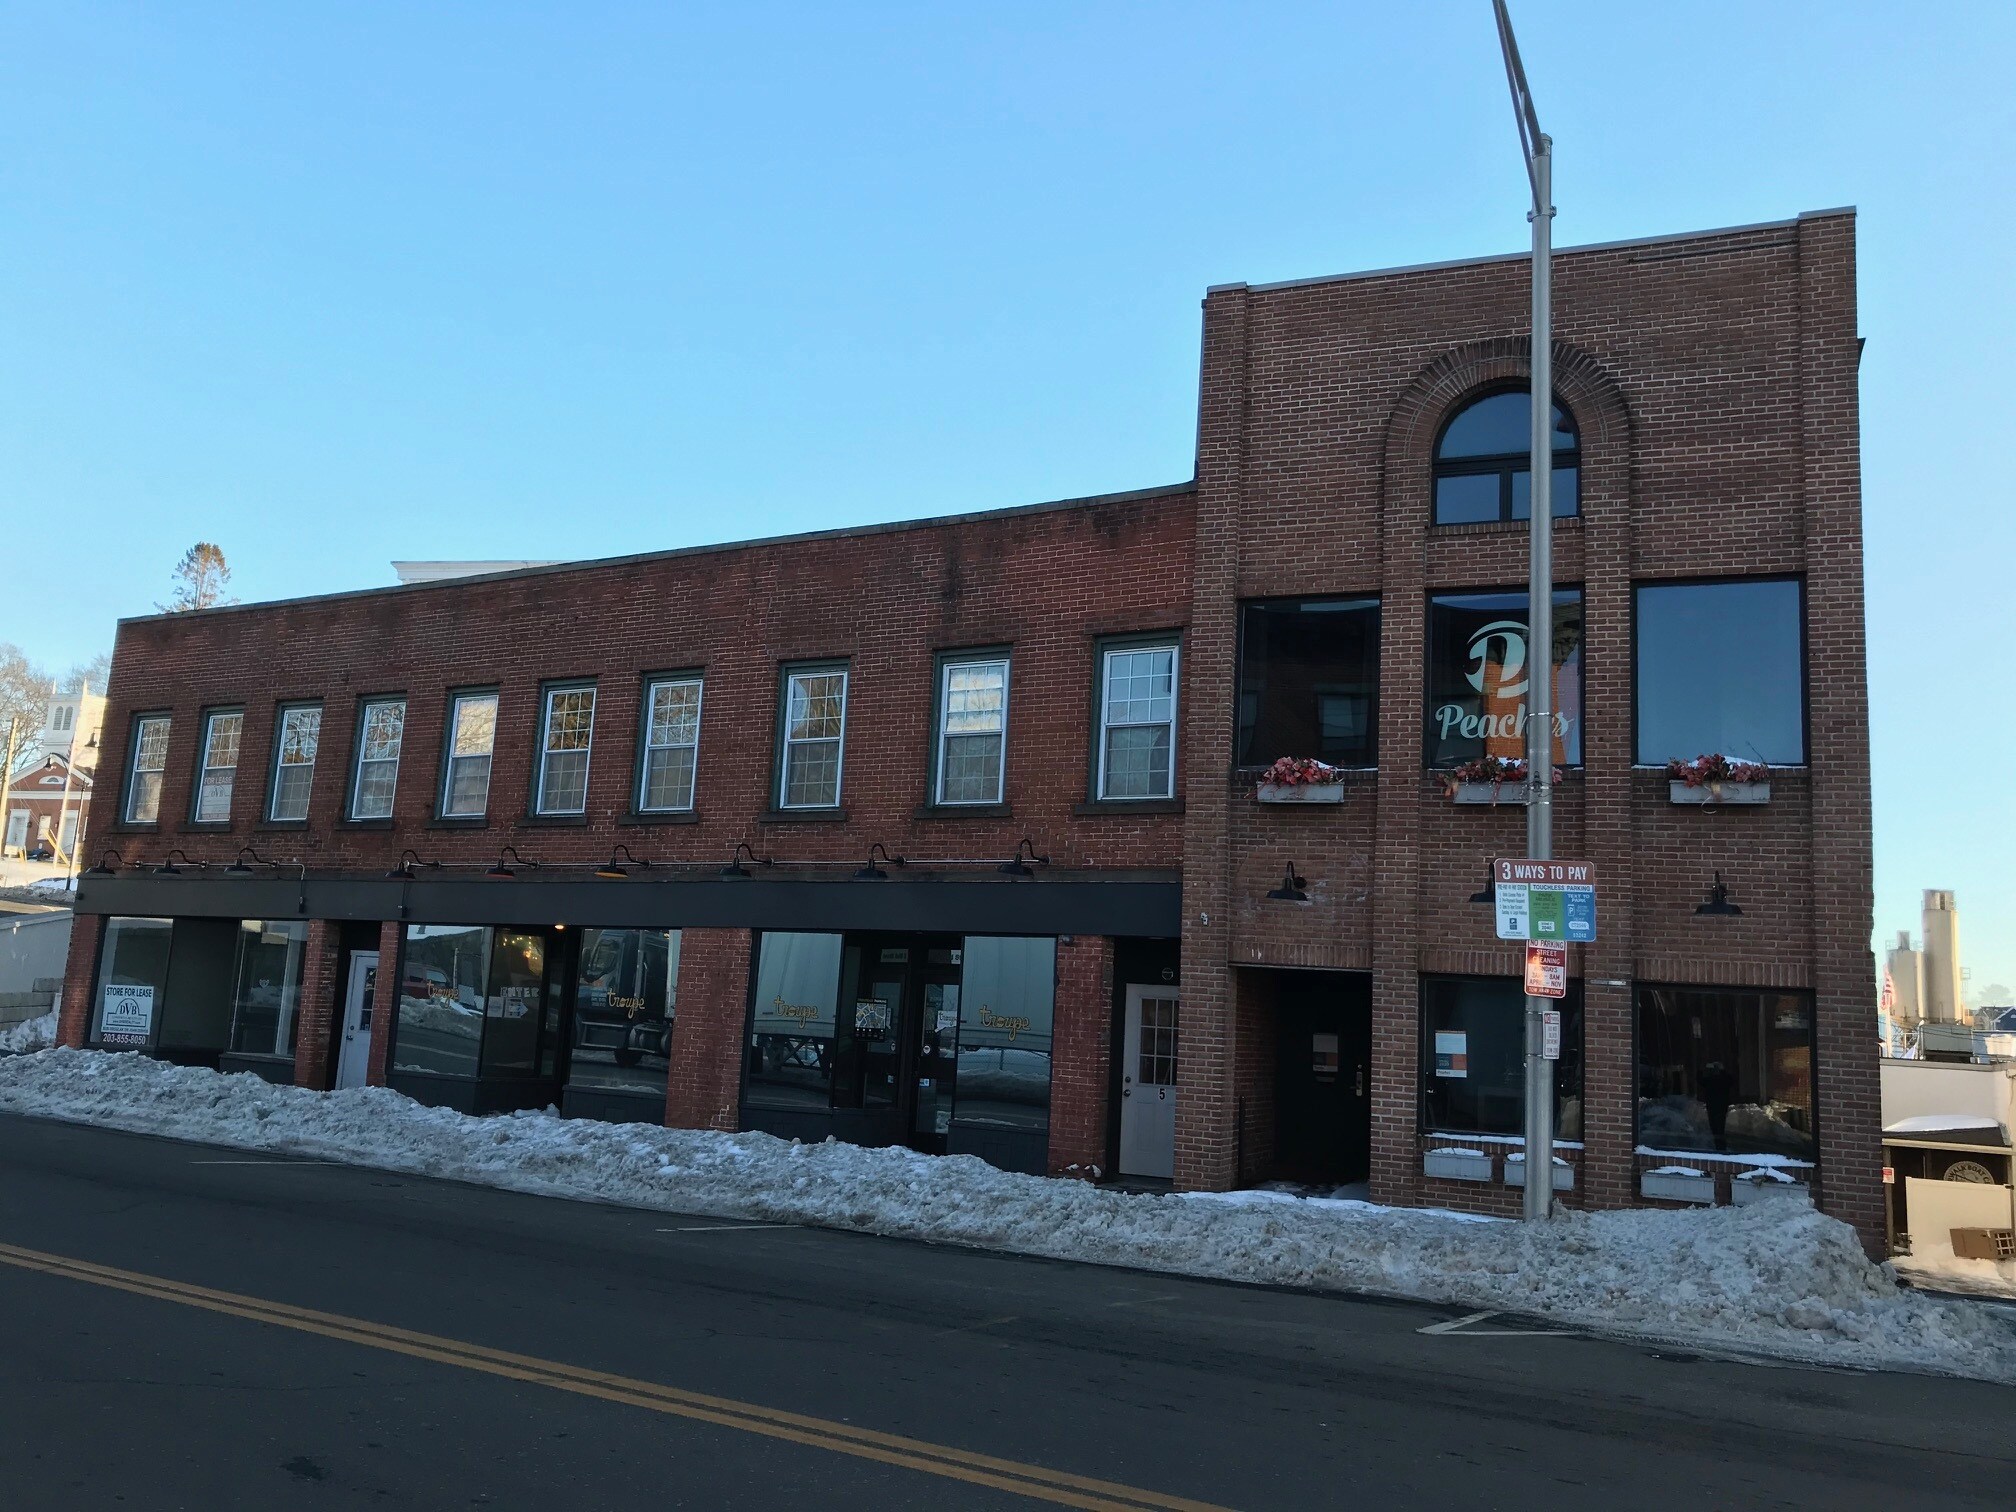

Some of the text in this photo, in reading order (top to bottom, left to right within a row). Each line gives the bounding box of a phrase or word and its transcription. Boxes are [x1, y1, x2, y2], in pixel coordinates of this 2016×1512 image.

[1434, 702, 1574, 741] Peachs
[216, 776, 233, 784] LEASE
[1502, 862, 1587, 880] 3 WAYS TO PAY
[1540, 940, 1564, 949] PARKING
[106, 987, 152, 997] STORE FOR LEASE
[500, 986, 540, 998] ENTER
[120, 1003, 136, 1015] DVB
[607, 987, 646, 1019] troupe
[774, 995, 818, 1029] troupe
[979, 1004, 1031, 1041] troupe
[1159, 1088, 1166, 1101] 5
[1968, 1165, 1986, 1176] BOAT
